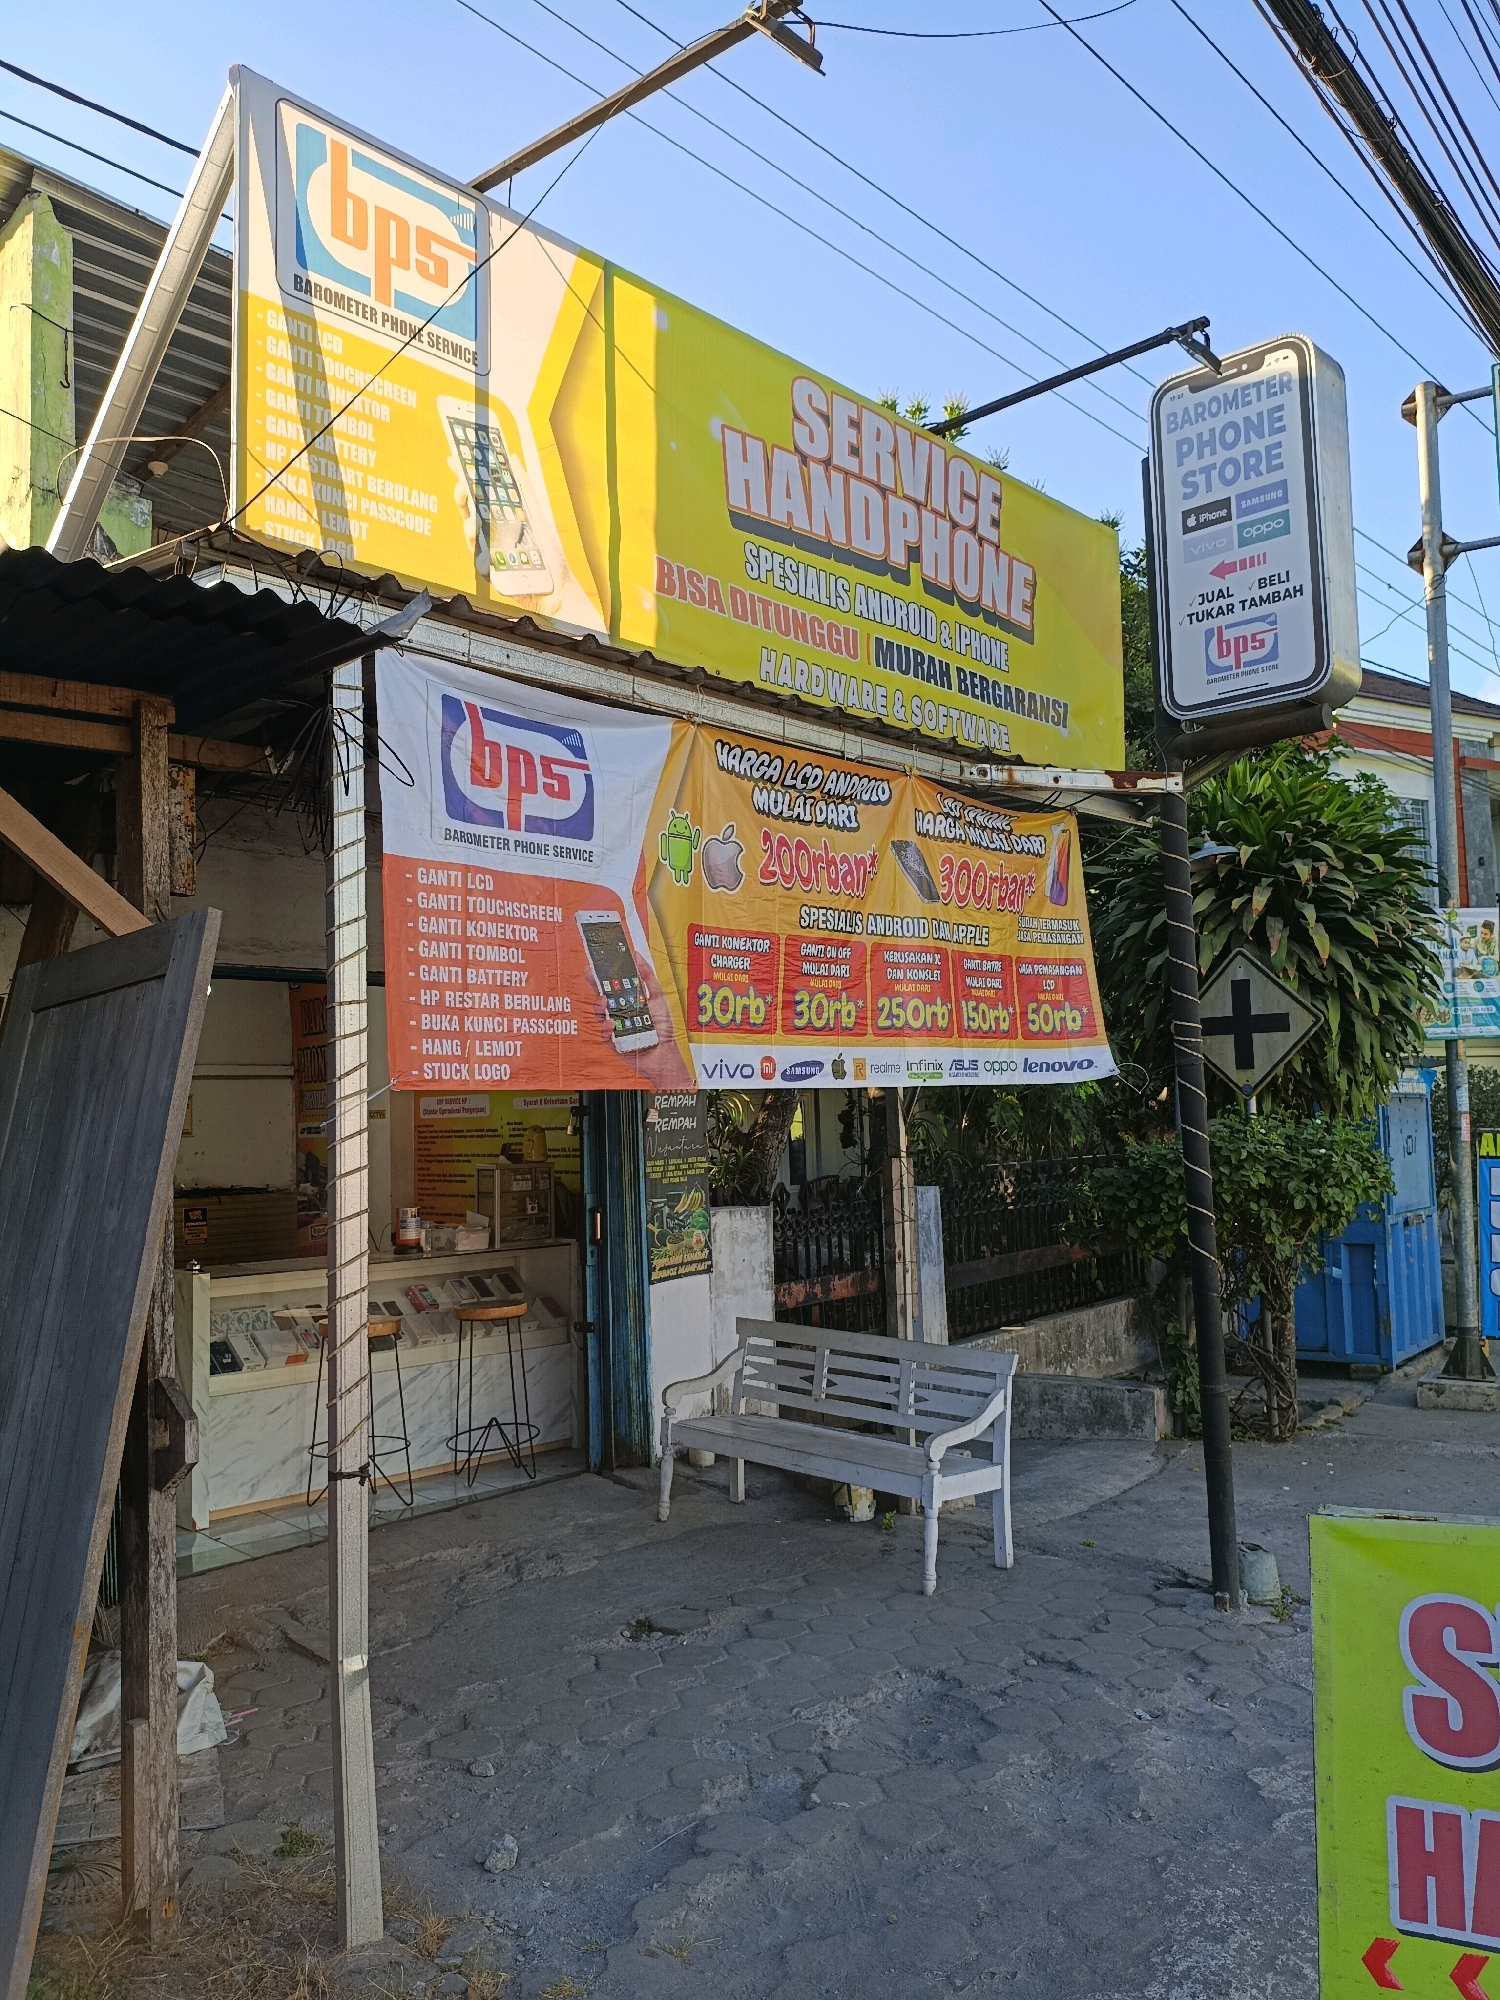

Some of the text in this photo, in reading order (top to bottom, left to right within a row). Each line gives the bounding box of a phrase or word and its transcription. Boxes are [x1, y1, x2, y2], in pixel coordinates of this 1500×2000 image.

[331, 138, 477, 307] bps
[266, 310, 343, 354] GANTI LCD
[294, 274, 478, 367] BAROMETER PHONE SERVICE
[266, 335, 416, 408] GANTI TOUCHSCREEN
[266, 362, 390, 423] GANTI KONEKTOR
[1166, 371, 1292, 434] BAROMETER
[266, 388, 375, 442] GANTI TOMBOL
[266, 414, 377, 467] GANTI BATTERY
[1176, 404, 1286, 468] PHONE
[791, 375, 1001, 543] SERVICE
[1181, 441, 1284, 500] STORE
[265, 440, 438, 514] HP RESTRART BERULANG
[265, 467, 432, 536] BUKA KUNCI PASSCODE
[265, 494, 369, 540] HANG LEMOT
[1198, 490, 1282, 523] iPhone SAMSUNG
[265, 520, 356, 562] STUCK LOGO
[721, 424, 1035, 630] HANDPHONE
[1191, 518, 1284, 554] vivo oppo
[1198, 570, 1290, 606] JUAL BELI
[744, 541, 1009, 673] SPESIALIS ANDROID & IPHONE
[1187, 584, 1304, 626] TUKAR TAMBAH
[655, 554, 1070, 730] BISA DITUNGGU MURAH BERGARANSI
[1216, 625, 1278, 670] bps
[1206, 663, 1279, 685] BAROMETER PHONE STORE
[760, 647, 1010, 752] HARDWARE & SOFTWARE
[464, 701, 590, 832] bps
[715, 741, 891, 803] HARGA LCD ANDROID
[753, 786, 858, 828] MULAI DARI
[444, 828, 594, 863] BAROMETER PHONE SERVICE
[915, 809, 1046, 857] HARGA MULAI DARI
[418, 868, 494, 890] GANTI LCD
[418, 892, 562, 922] GANTI TOUCHSCREEN
[418, 916, 538, 942] GANTI KONEKTOR
[800, 905, 989, 946] SPESIALIS ANDROID DAN APPLE
[1018, 916, 1080, 932] SUDAH TERMASUK
[1018, 930, 1084, 944] JASA PEMASANGAN
[418, 940, 526, 964] GANTI TOMBOL
[694, 932, 770, 953] GANTI KONEKTOR
[800, 943, 852, 959] GANTI ON OFF
[884, 950, 932, 964] KERUSAKAN
[419, 965, 528, 987] GANTI BATTERY
[711, 954, 750, 970] CHARGER
[713, 972, 748, 982] MULAI DARI
[802, 962, 850, 978] MULAI DARI
[887, 968, 941, 982] DAN KONSLET
[1018, 964, 1082, 976] JASA PEMASANGAN
[810, 978, 842, 989] MULAI DARI
[895, 984, 930, 992] MULAI DARI
[965, 975, 1002, 989] MULAI DARI
[1042, 979, 1056, 990] LCD
[420, 990, 570, 1013] HP RESTAR BERULANG
[421, 1014, 578, 1035] BUKA KUNCI PASSCODE
[422, 1038, 462, 1056] HANG
[476, 1040, 522, 1057] LEMOT
[424, 1063, 510, 1080] STUCK LOGO
[702, 1058, 754, 1078] vivo
[786, 1066, 820, 1076] SAMSUNG
[870, 1062, 900, 1074] realme
[906, 1059, 943, 1071] Infinix
[949, 1059, 978, 1071] ASUS
[984, 1060, 1018, 1076] oppo
[1023, 1058, 1095, 1073] lenovo
[439, 1108, 461, 1116] Operasional
[524, 1098, 538, 1107] Syarat
[544, 1097, 568, 1106] Ketentuan
[654, 1094, 696, 1110] REMPAH
[655, 1117, 697, 1132] REMPAH
